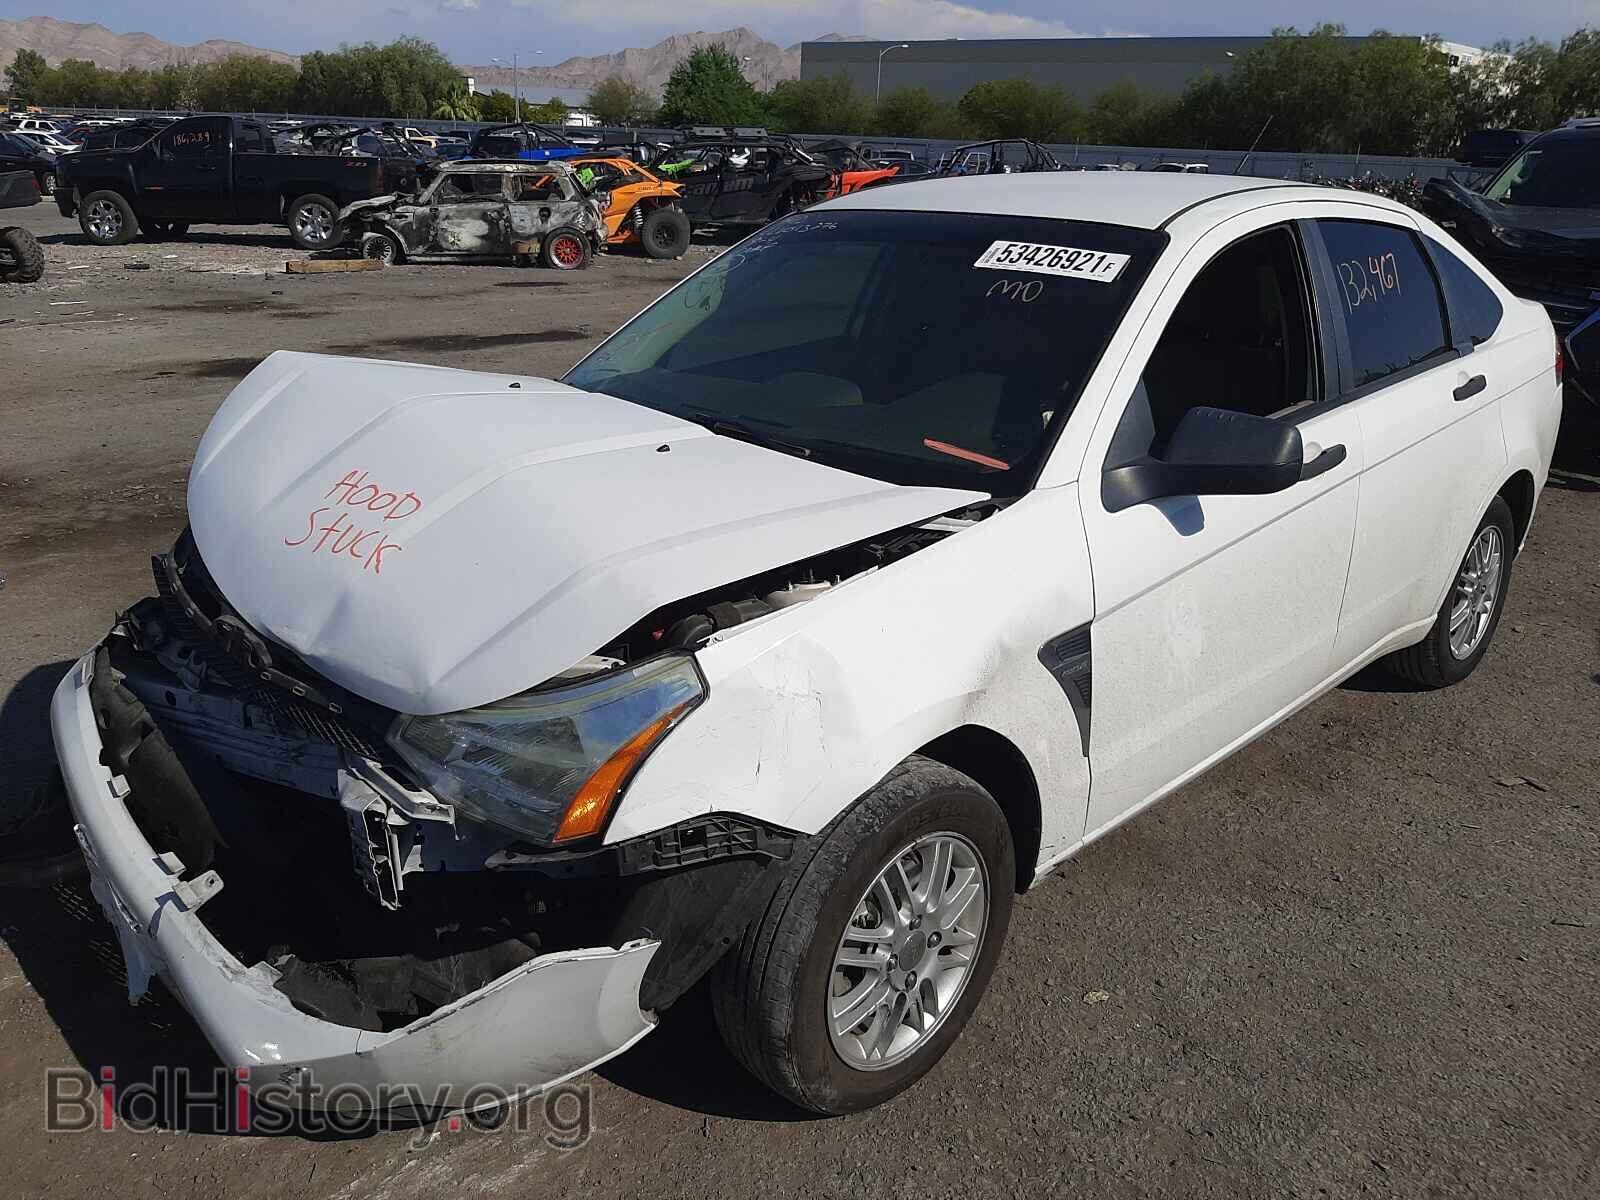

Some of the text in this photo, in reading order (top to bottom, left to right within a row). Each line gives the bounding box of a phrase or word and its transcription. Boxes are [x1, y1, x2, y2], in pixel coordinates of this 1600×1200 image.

[995, 243, 1107, 274] 53426921
[1102, 262, 1115, 273] F
[1336, 253, 1401, 315] 132,467
[323, 470, 421, 522] HOOD
